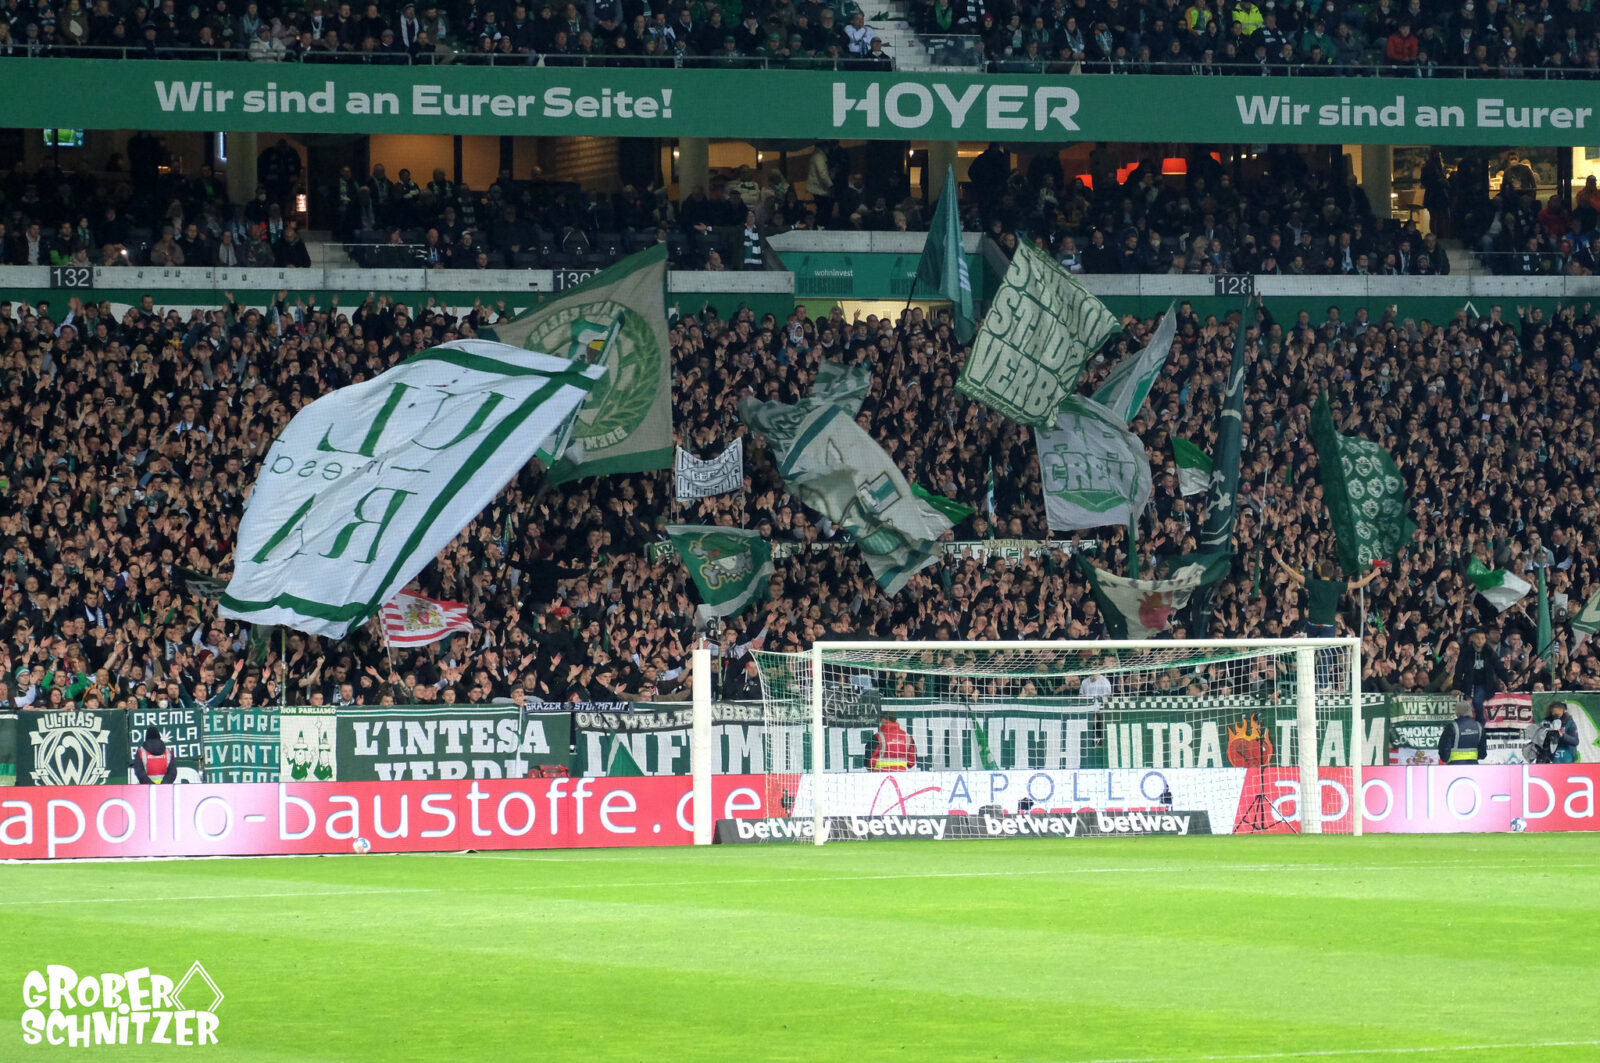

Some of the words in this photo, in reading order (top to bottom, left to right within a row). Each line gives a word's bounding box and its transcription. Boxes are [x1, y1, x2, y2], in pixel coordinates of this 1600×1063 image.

[154, 80, 234, 114] Wir
[242, 82, 336, 115] sind
[345, 92, 400, 116] an
[412, 85, 536, 118] Eurer
[543, 87, 673, 119] Seite!
[832, 82, 1080, 132] HOYER
[1235, 95, 1310, 126] Wir
[1319, 95, 1409, 129] sind
[1416, 103, 1465, 127] an
[1477, 99, 1592, 130] Eurer
[53, 268, 90, 287] 132
[814, 269, 853, 277] wohninvest
[1217, 276, 1252, 295] 128
[44, 712, 96, 729] ULTRAS
[134, 711, 195, 726] CREME
[203, 714, 280, 732] SEMPRE
[576, 711, 620, 730] OUR
[620, 712, 674, 730] WILL
[1485, 704, 1532, 721] VEC
[176, 727, 198, 741] LA
[353, 719, 550, 756] L'INTESA
[1106, 721, 1223, 769] ULTRA
[1276, 717, 1386, 767] TAM
[205, 744, 280, 765] AVANTI
[949, 770, 1168, 804] APOLLO
[850, 815, 947, 840] betway
[984, 814, 1078, 838] betway
[1098, 812, 1191, 836] betway
